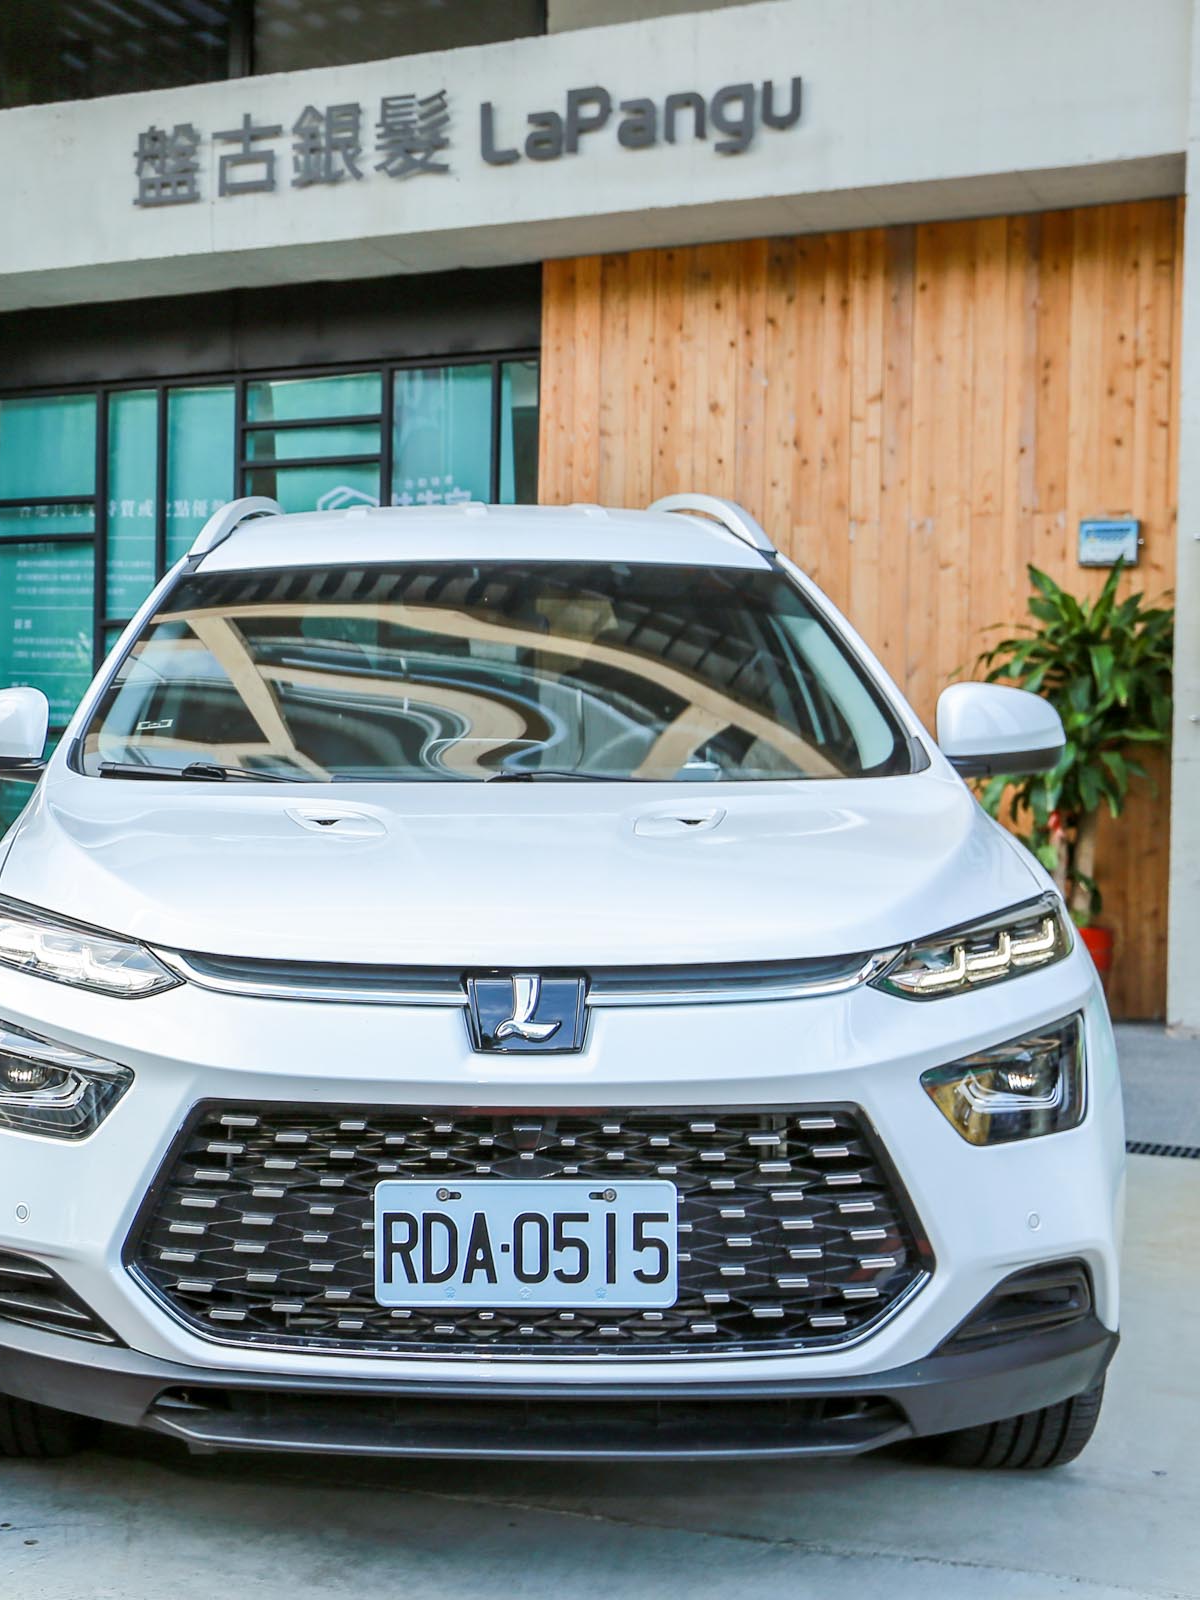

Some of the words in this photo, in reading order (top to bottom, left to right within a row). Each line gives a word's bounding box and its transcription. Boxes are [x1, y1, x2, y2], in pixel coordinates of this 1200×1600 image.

[133, 89, 451, 207] 盤古銀髮
[480, 77, 803, 165] LaPangu
[382, 1212, 669, 1285] RDA-0515
